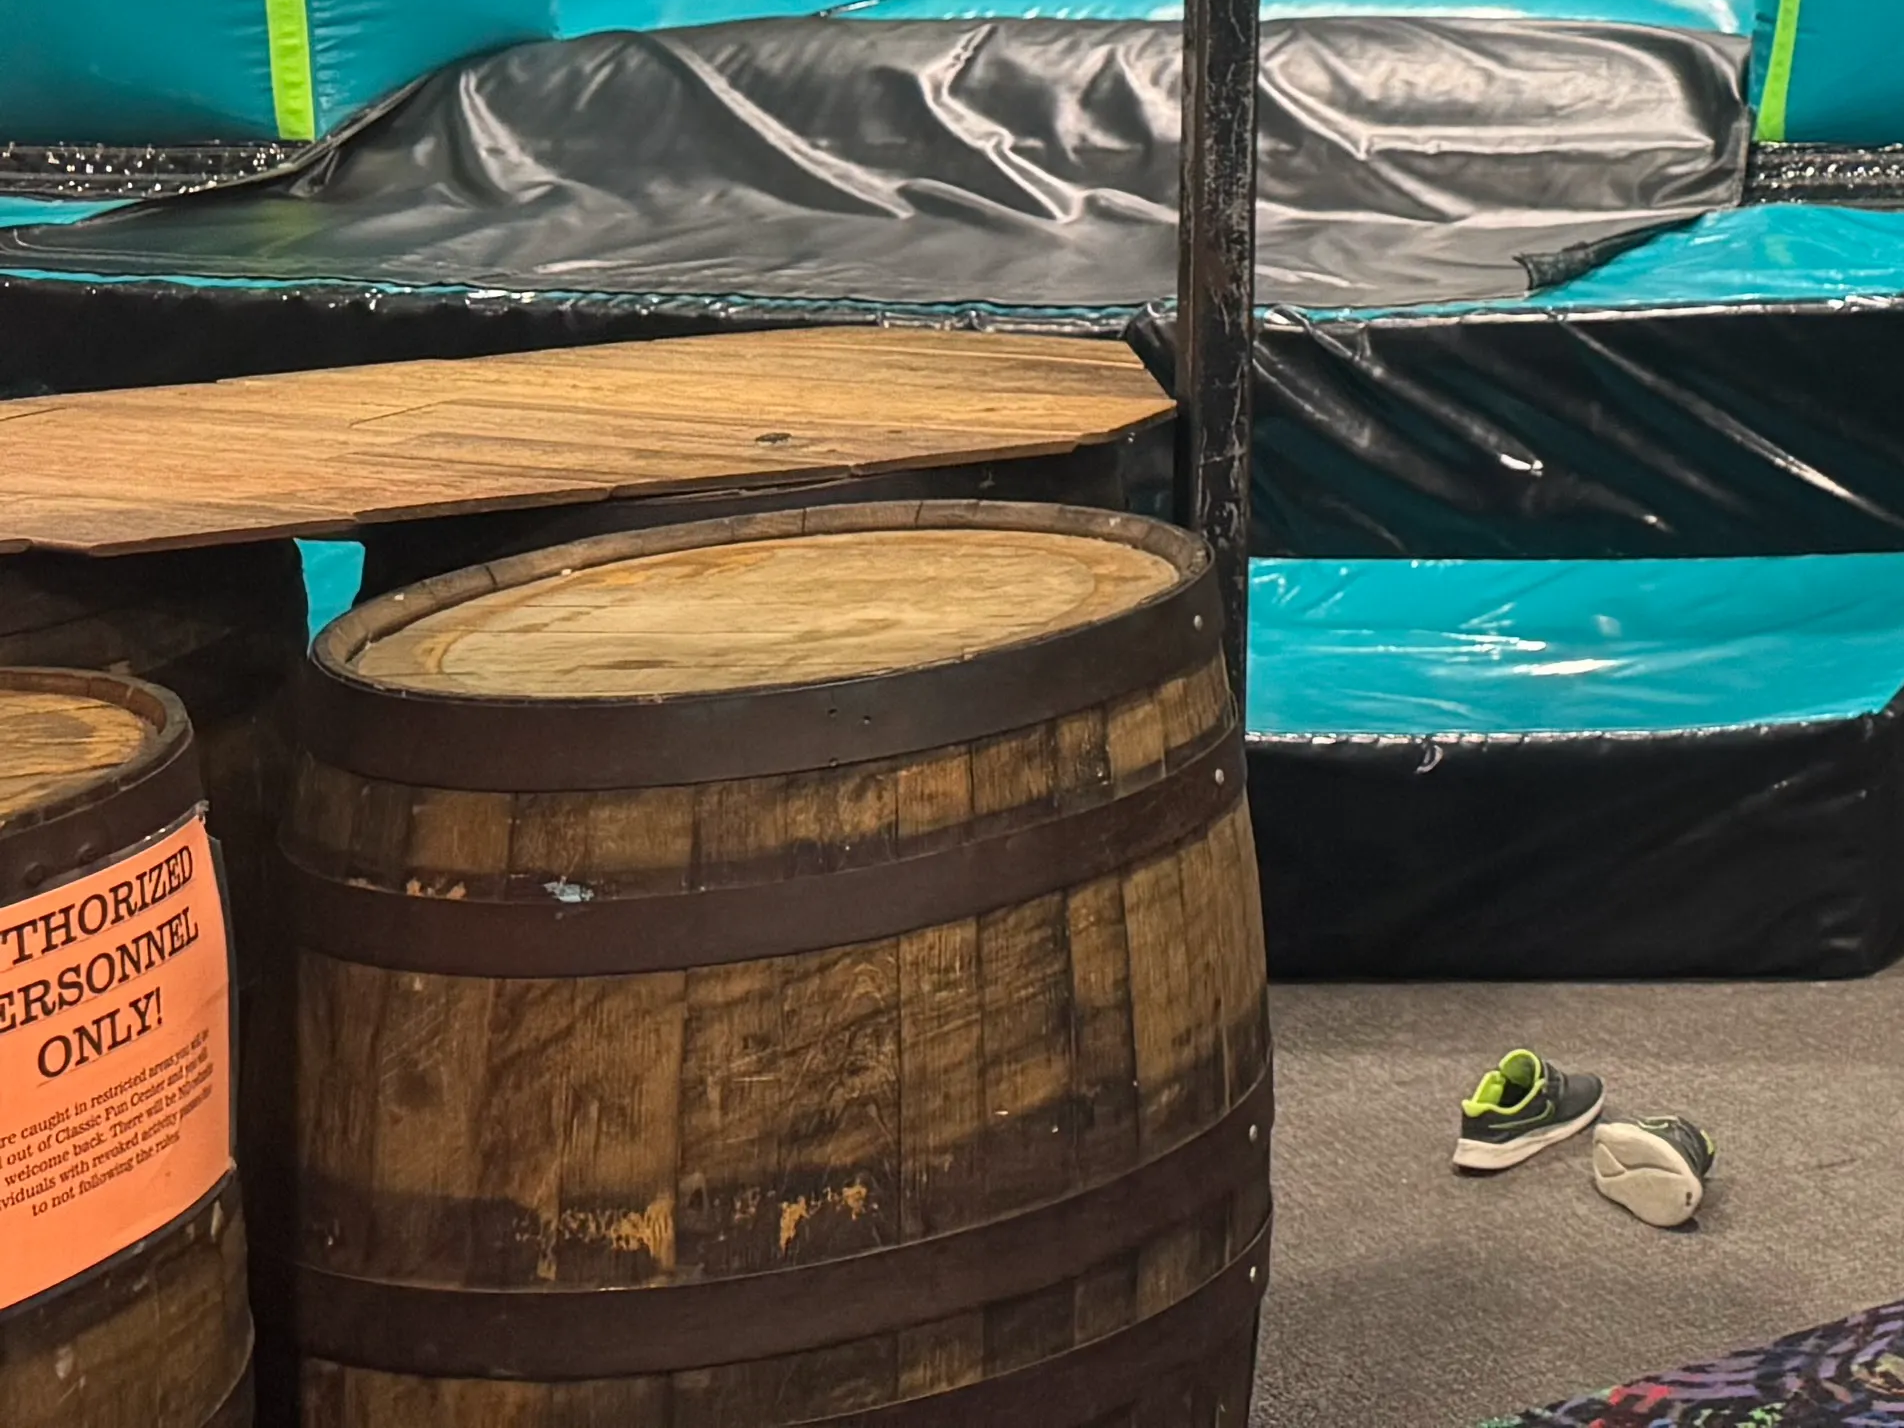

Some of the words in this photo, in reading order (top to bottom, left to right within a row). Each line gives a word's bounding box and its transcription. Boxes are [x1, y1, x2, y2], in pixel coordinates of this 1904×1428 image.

[0, 845, 193, 966] THORIZED
[0, 906, 199, 1033] ERSONNEL
[37, 986, 163, 1079] ONLY!
[6, 1144, 34, 1166] out
[37, 1134, 53, 1153] of
[55, 1113, 103, 1145] Classic
[105, 1101, 128, 1122] Fun
[131, 1079, 165, 1107] Center
[21, 1107, 71, 1140] caught
[74, 1101, 87, 1116] in
[90, 1068, 147, 1109] restricted
[0, 1176, 57, 1211] viduals
[59, 1159, 90, 1183] with
[92, 1132, 139, 1169] revoked
[4, 1149, 70, 1186] welcome
[109, 1111, 144, 1138] There
[31, 1200, 48, 1217] to
[51, 1186, 76, 1208] not
[79, 1156, 134, 1195] following
[136, 1146, 154, 1165] the
